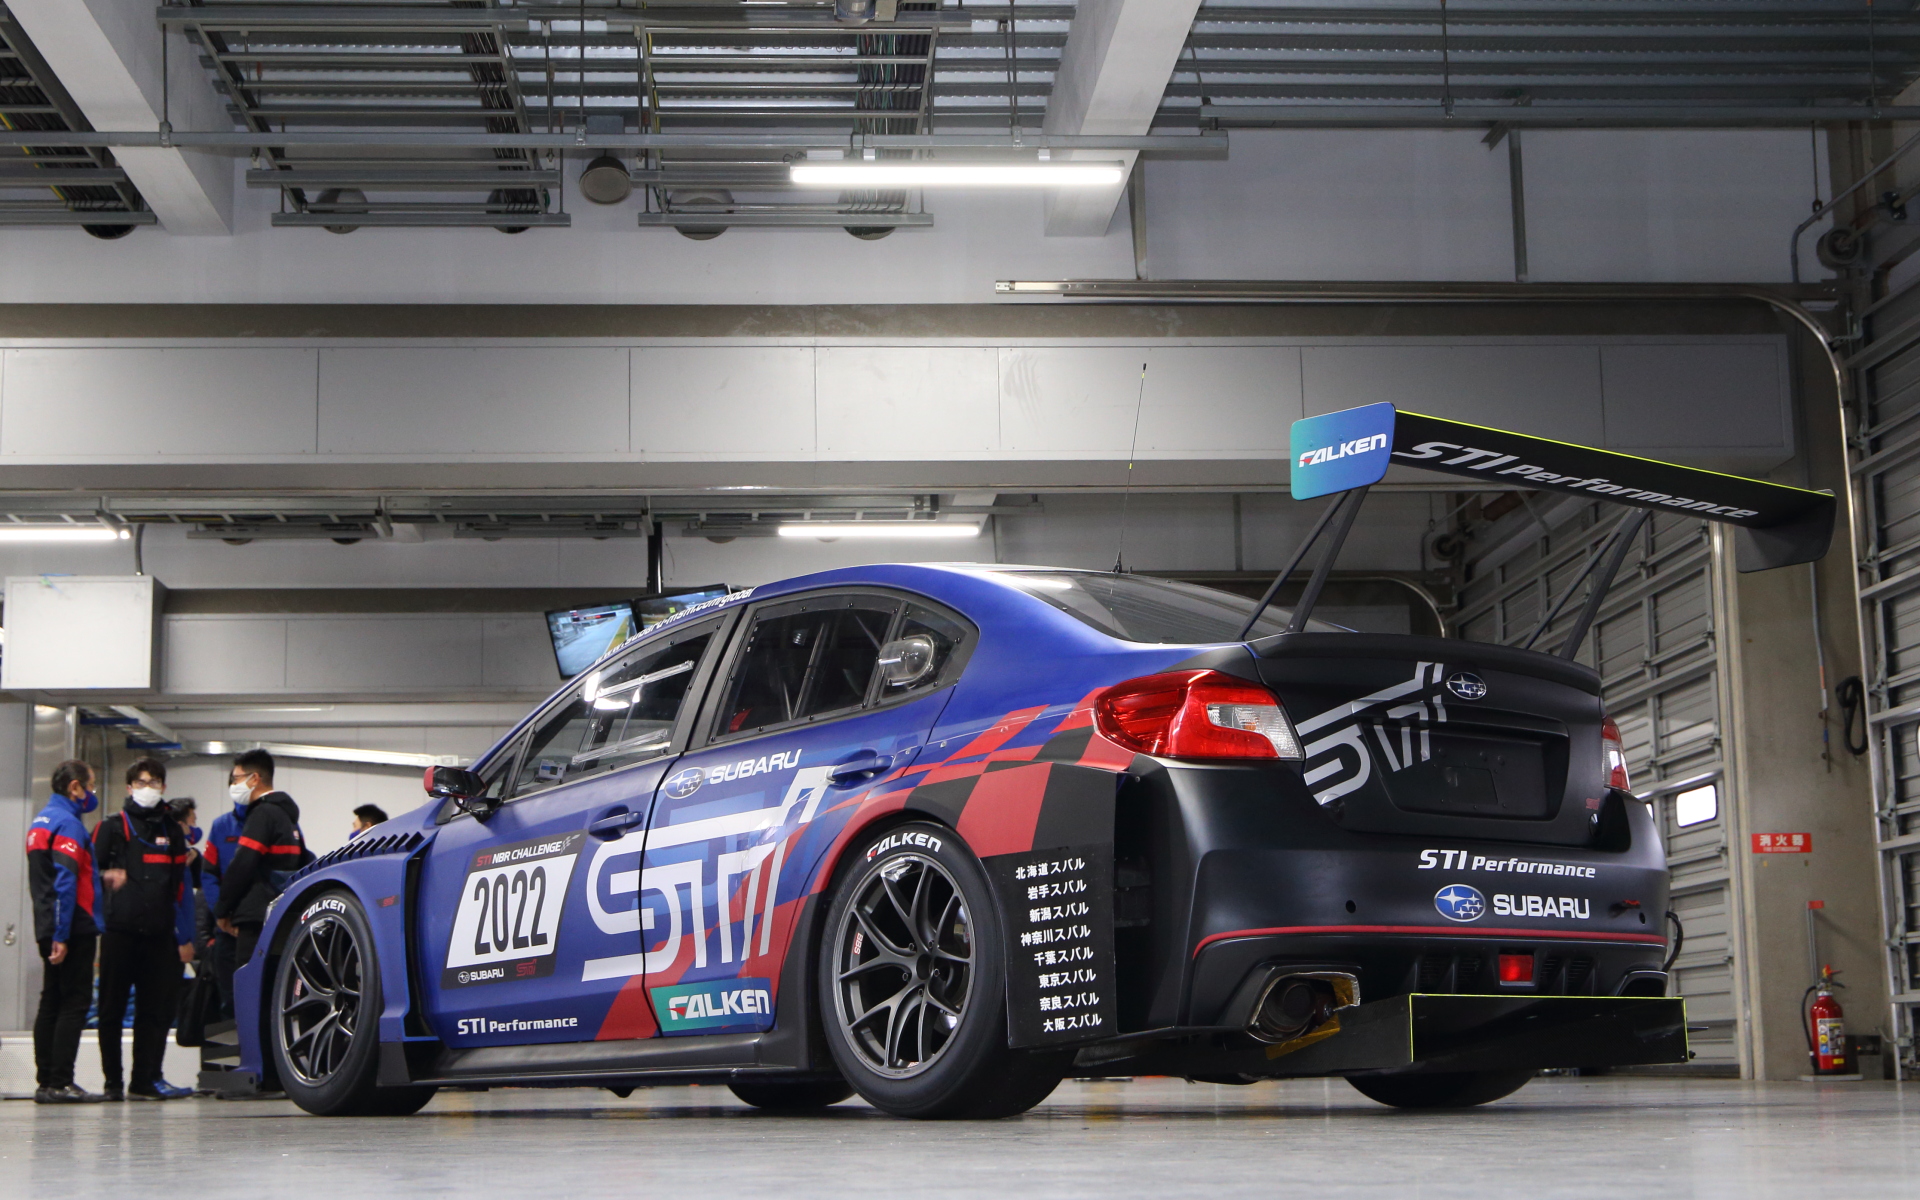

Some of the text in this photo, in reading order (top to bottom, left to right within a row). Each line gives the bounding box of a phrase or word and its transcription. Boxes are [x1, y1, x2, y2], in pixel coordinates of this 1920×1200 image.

[1298, 433, 1387, 468] FALKEN
[1391, 441, 1759, 520] STI Performance
[710, 749, 802, 785] SUBARU
[866, 831, 942, 863] FALKEN
[1759, 834, 1804, 846] 消火器
[476, 841, 562, 867] STI NBR CHALLENGE
[1417, 849, 1596, 878] STI Performance
[1015, 857, 1086, 880] 北海道スバル
[1027, 879, 1087, 901] 岩手スバル
[300, 898, 347, 925] FALKEN
[474, 865, 548, 956] 2022
[1029, 901, 1090, 923] 新潟スバル
[1493, 894, 1590, 919] SUBARU
[853, 932, 863, 955] BBS
[1020, 924, 1091, 946] 神奈川スバル
[1034, 946, 1094, 967] 千葉スバル
[470, 968, 505, 981] SUBARU
[1038, 968, 1097, 989] 東京スバル
[667, 989, 771, 1021] FALKEN
[1039, 991, 1100, 1011] 奈良スバル
[457, 1015, 578, 1035] STI Performance
[1043, 1013, 1103, 1033] 大阪スバル
